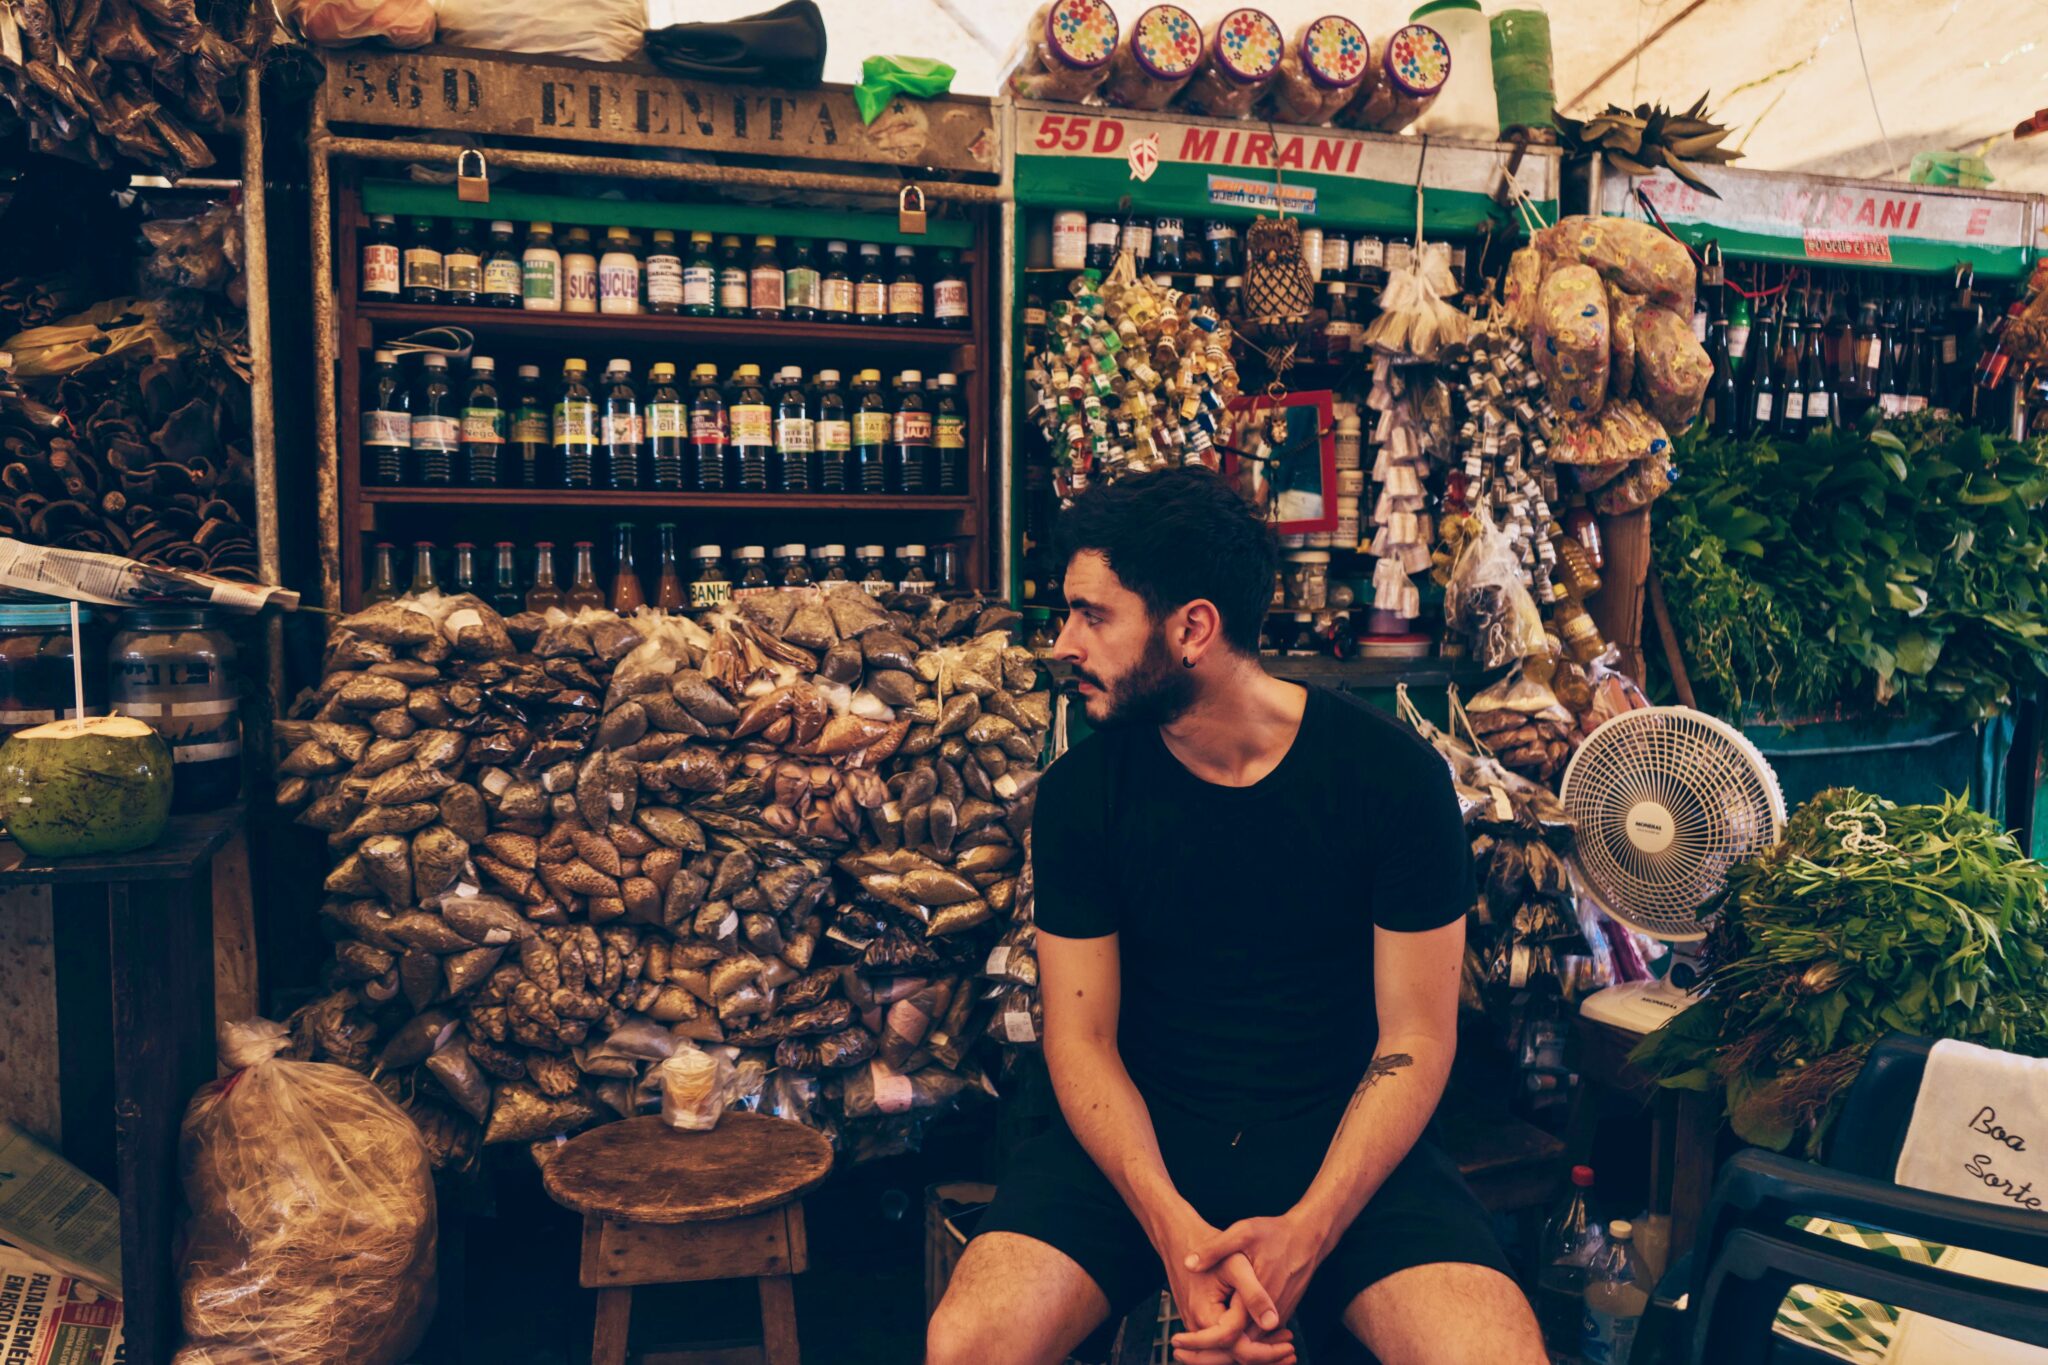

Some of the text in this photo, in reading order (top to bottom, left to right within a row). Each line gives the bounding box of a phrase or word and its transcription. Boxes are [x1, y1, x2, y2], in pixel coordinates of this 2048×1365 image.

[1034, 115, 1364, 173] 55D MIRANI
[1966, 207, 1992, 235] E
[656, 420, 685, 431] elho
[691, 583, 733, 602] BANHO
[1968, 1106, 2026, 1151] Boa
[1964, 1154, 2043, 1212] Sorte
[4, 1274, 26, 1291] EM
[25, 1272, 51, 1305] FALTA
[19, 1304, 43, 1319] DE
